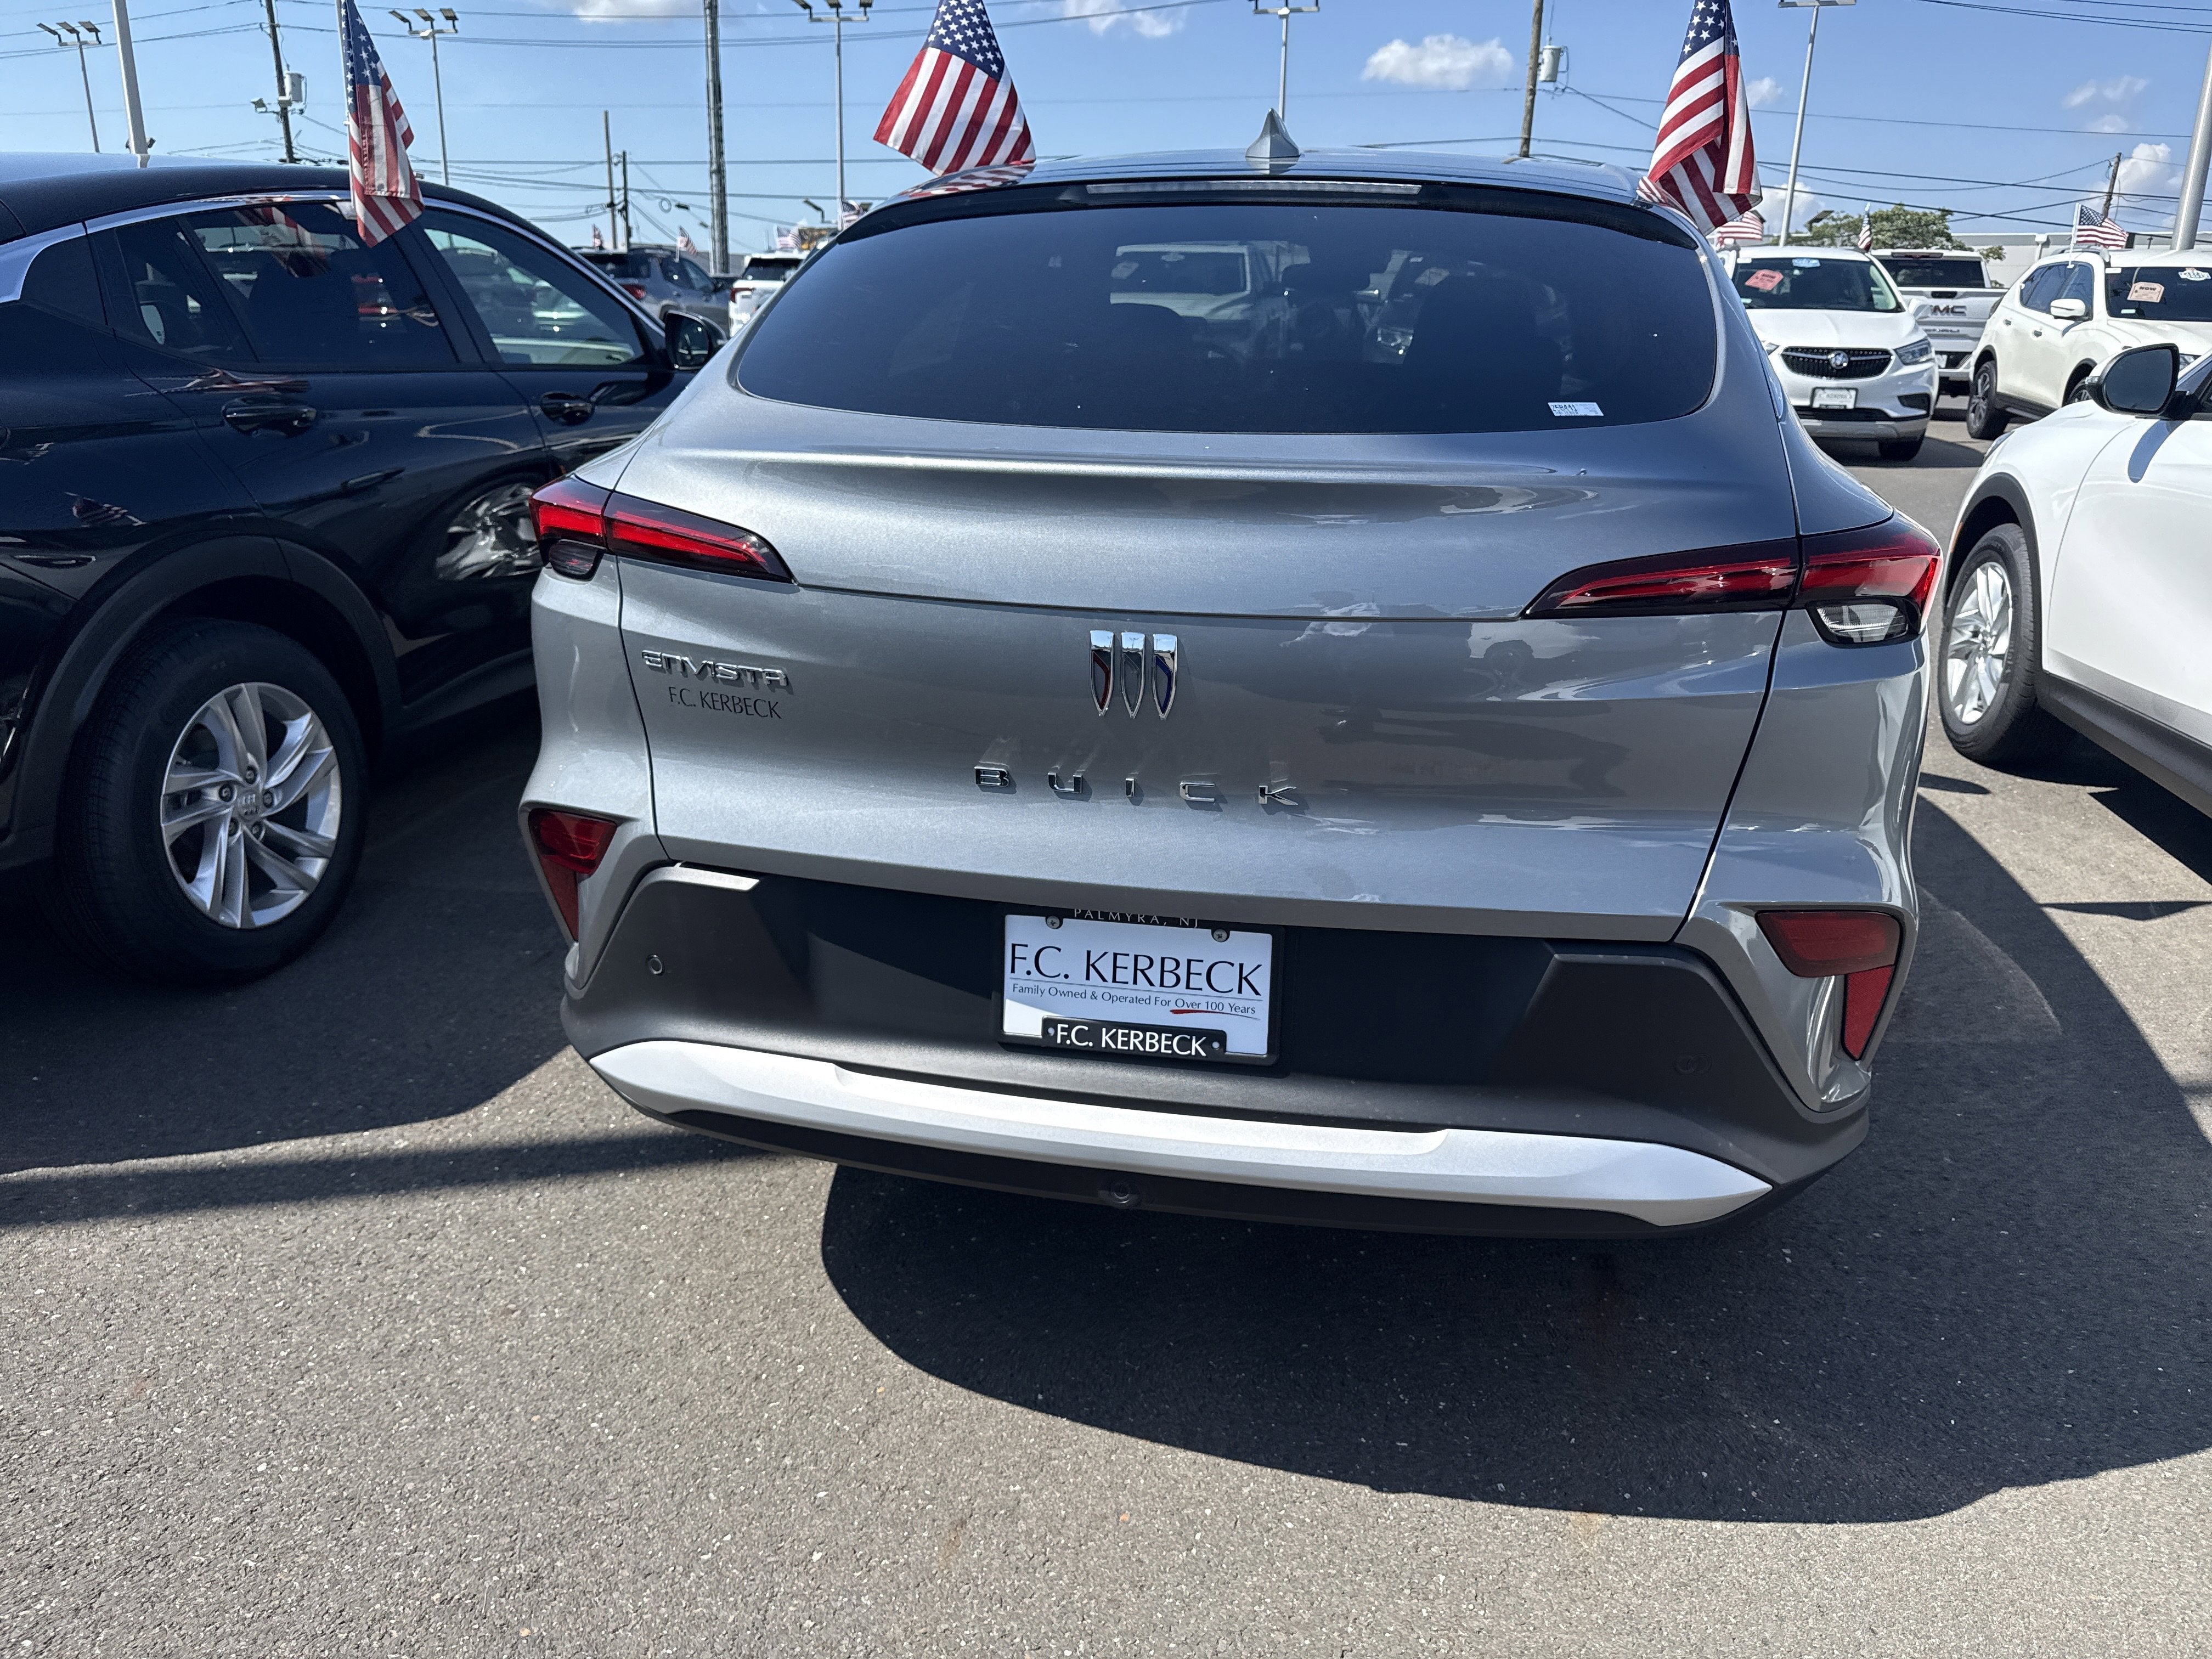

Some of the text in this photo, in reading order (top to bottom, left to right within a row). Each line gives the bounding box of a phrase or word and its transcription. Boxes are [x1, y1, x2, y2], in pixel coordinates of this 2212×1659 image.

[642, 650, 788, 686] ENVISTA
[668, 686, 782, 719] F.C. KERBECK
[974, 766, 1299, 806] BUICK
[1074, 908, 1198, 928] PALMYRA, NJ
[1011, 943, 1262, 996] F.C. KERBECK
[1013, 983, 1256, 1014] Family Owned & Operated For Over 100 Years
[1057, 1024, 1206, 1057] F.C. KERBECK
